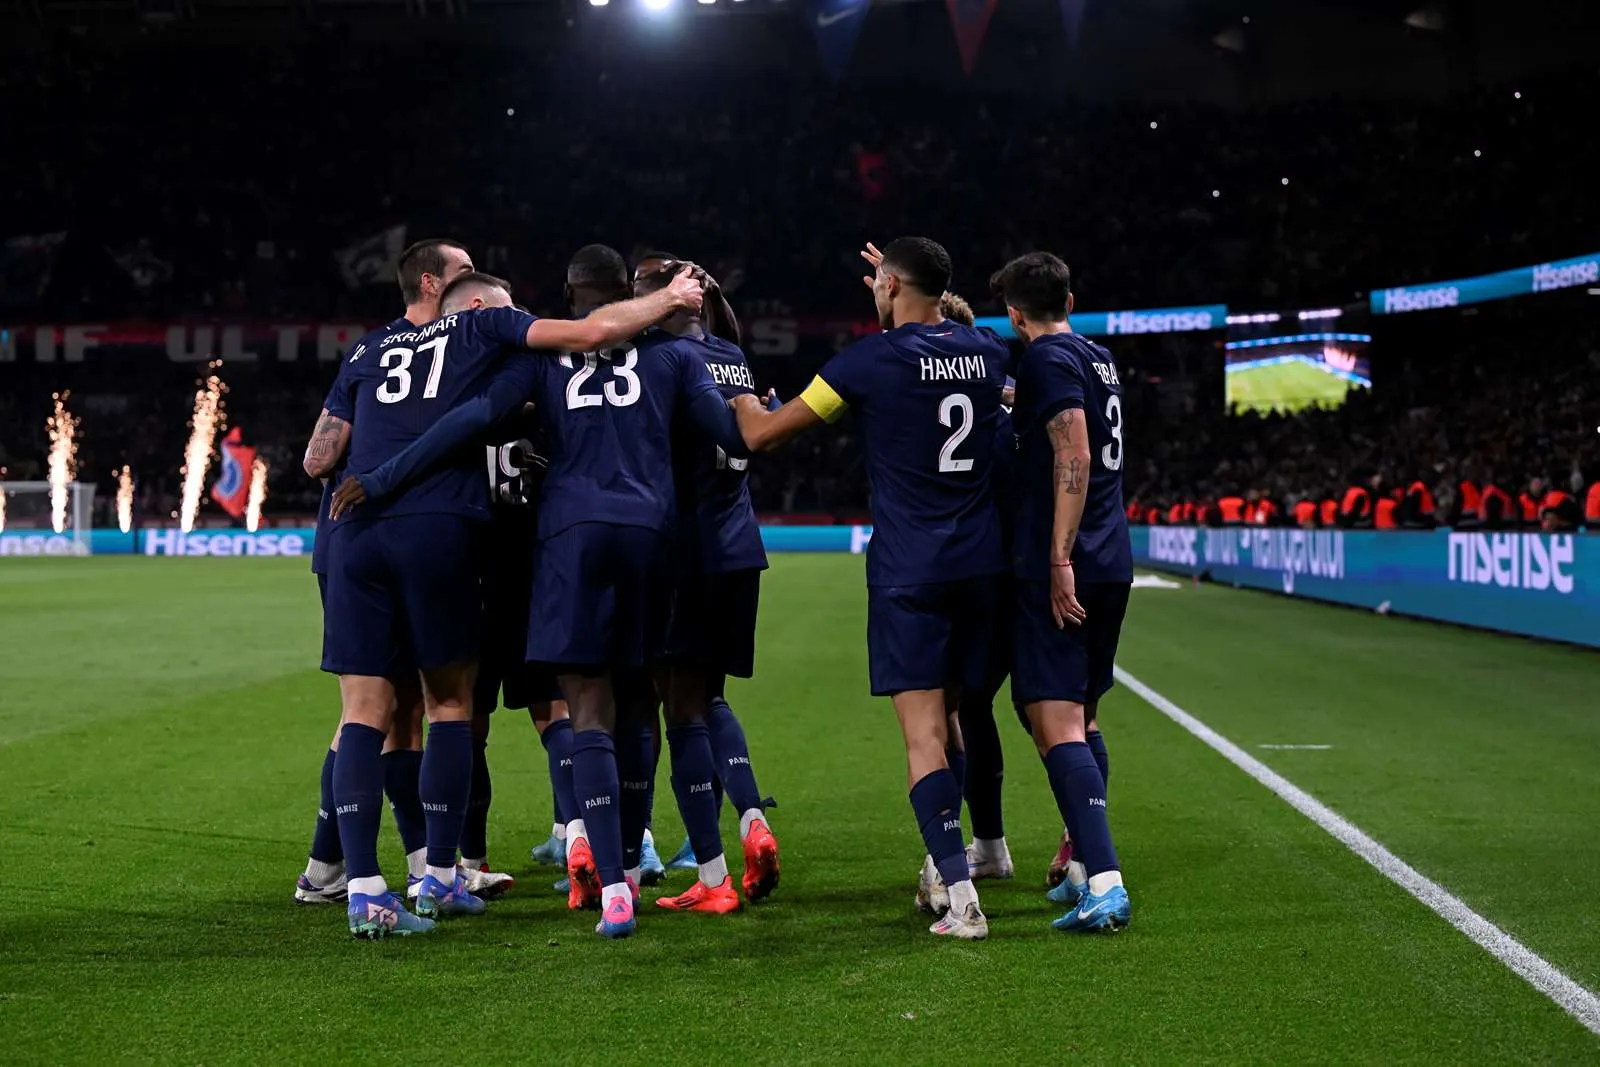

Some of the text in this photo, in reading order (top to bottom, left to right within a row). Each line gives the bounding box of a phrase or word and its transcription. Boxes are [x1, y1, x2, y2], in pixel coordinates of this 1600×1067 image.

[1532, 261, 1598, 292] Hisense
[1384, 287, 1460, 314] Hisense
[1105, 311, 1213, 335] Hisense
[165, 325, 367, 362] ULTR
[376, 334, 450, 404] 37
[559, 342, 641, 410] 23
[705, 362, 755, 391] EMBÉL
[920, 355, 987, 380] HAKIMI
[938, 393, 974, 472] 2
[1102, 394, 1123, 470] 3
[145, 528, 304, 556] Hisense
[585, 796, 611, 809] PARIS
